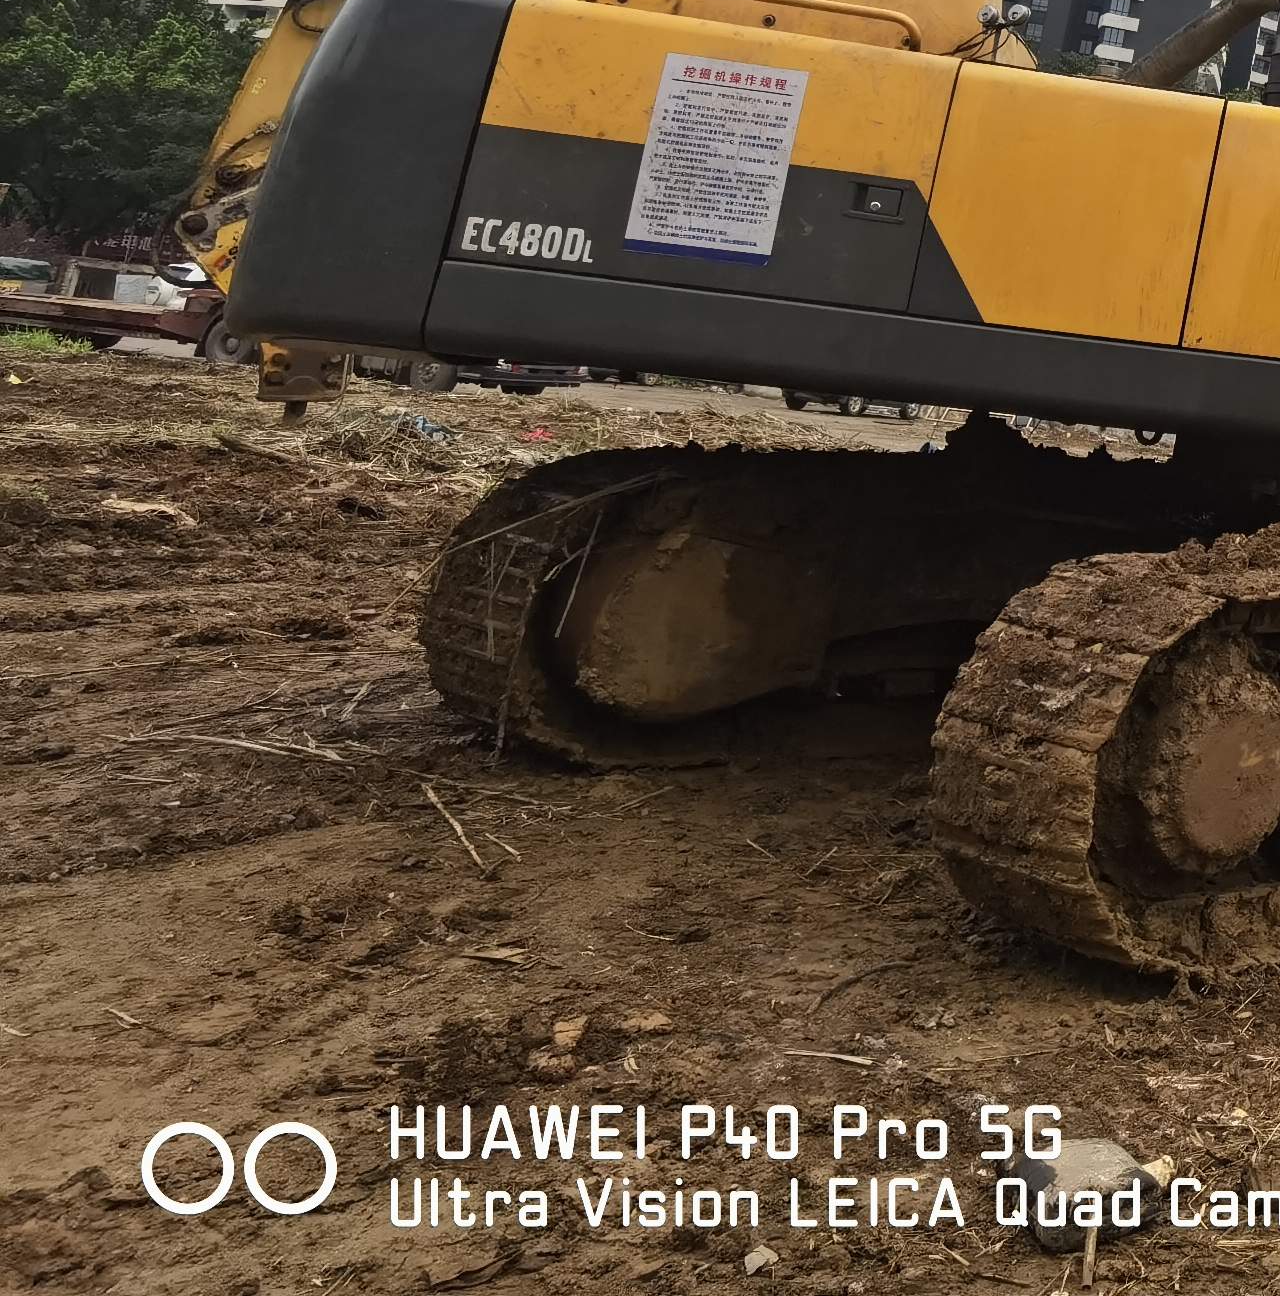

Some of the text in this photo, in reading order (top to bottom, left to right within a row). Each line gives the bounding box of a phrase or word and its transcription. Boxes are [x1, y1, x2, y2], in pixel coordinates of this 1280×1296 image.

[682, 65, 788, 91] 挖掘机操作规程
